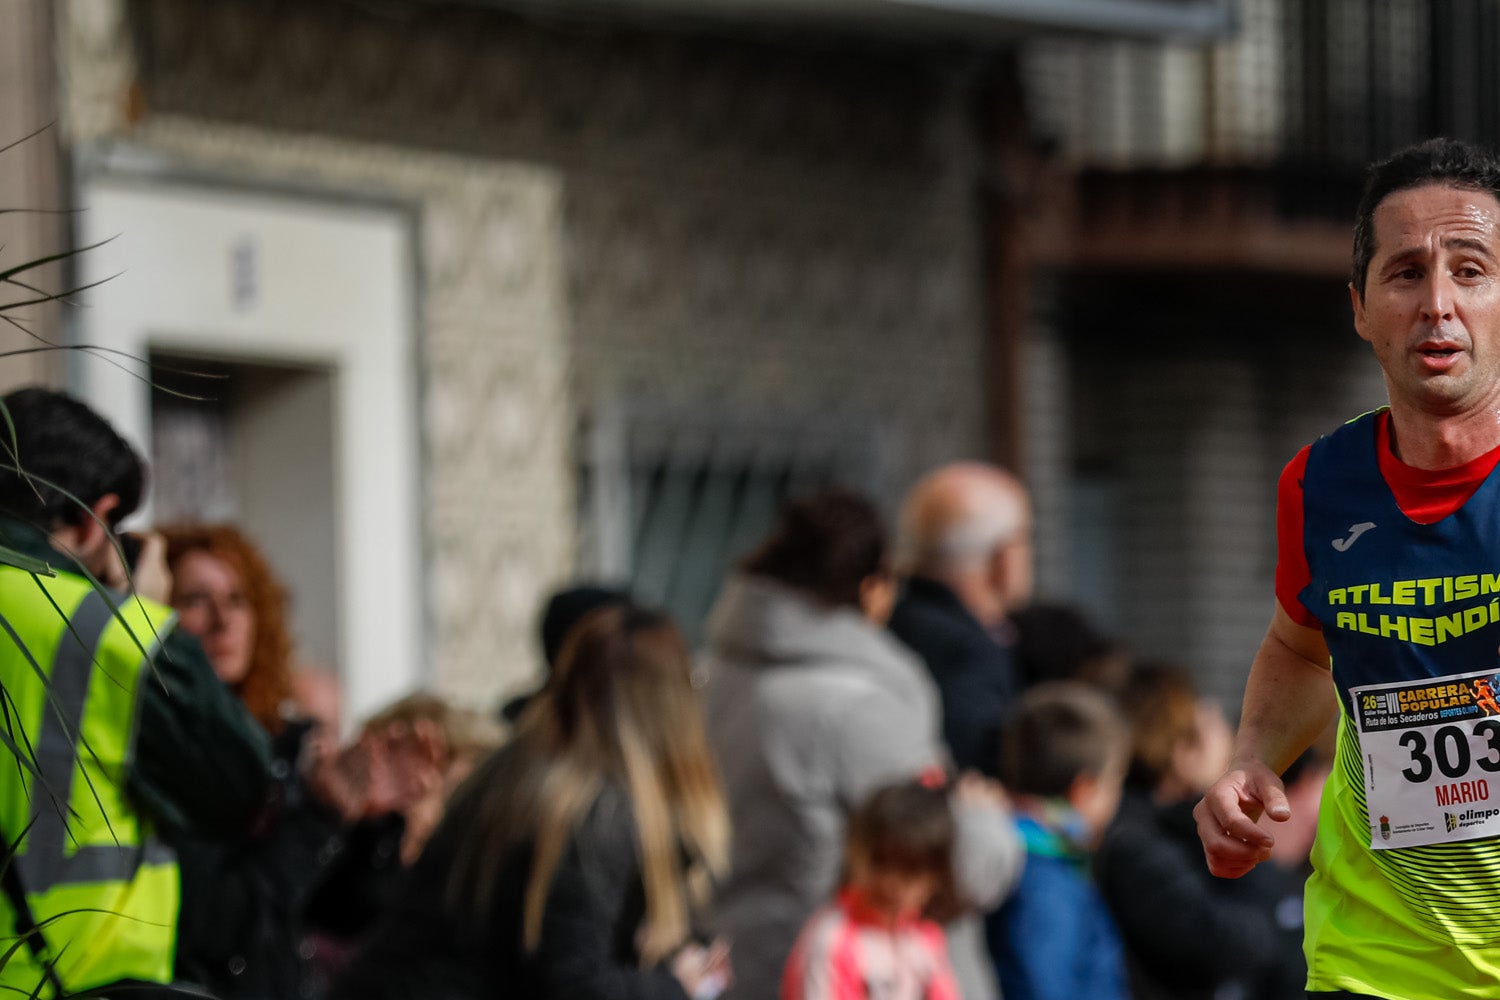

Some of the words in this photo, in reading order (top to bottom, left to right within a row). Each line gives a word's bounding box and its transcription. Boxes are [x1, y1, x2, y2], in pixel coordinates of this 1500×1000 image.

[1398, 683, 1470, 703] CARRERA
[1362, 695, 1377, 709] 26
[1400, 695, 1471, 713] POPULAR
[1365, 717, 1379, 727] Ruta
[1380, 717, 1387, 725] de
[1387, 715, 1399, 725] los
[1399, 712, 1439, 723] Secaderos
[1435, 779, 1489, 807] MARIO
[1459, 808, 1500, 821] olimpo
